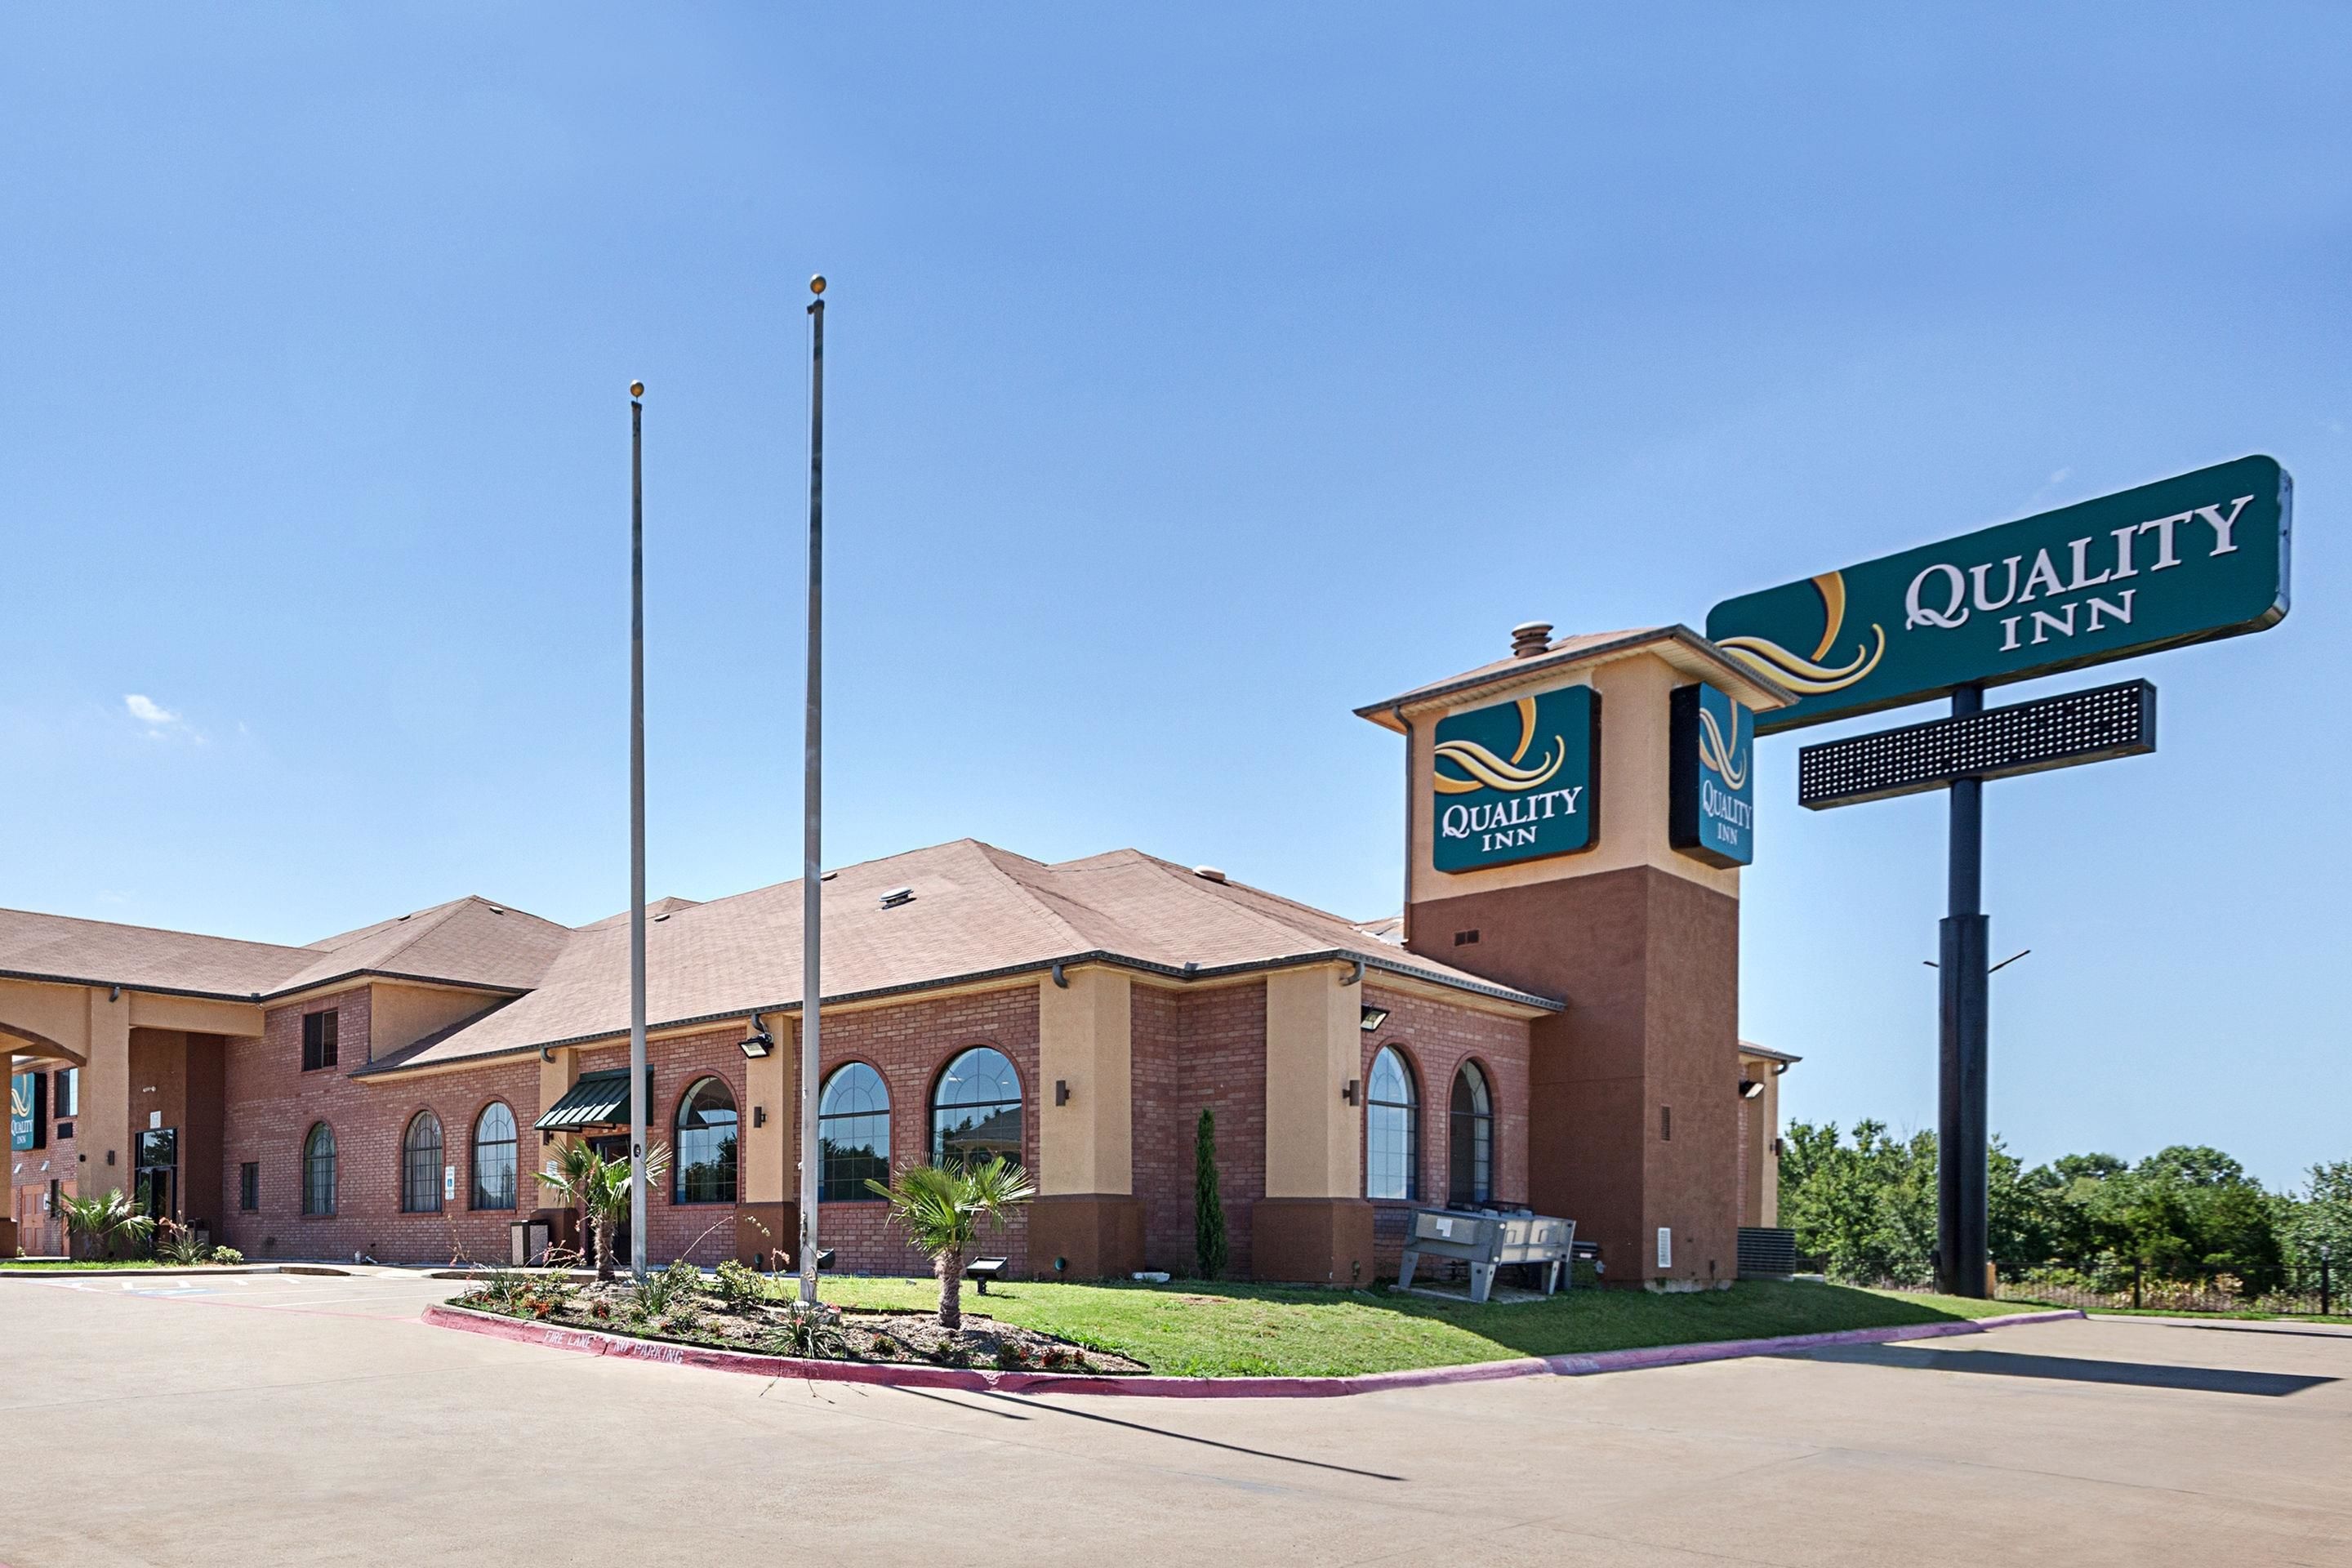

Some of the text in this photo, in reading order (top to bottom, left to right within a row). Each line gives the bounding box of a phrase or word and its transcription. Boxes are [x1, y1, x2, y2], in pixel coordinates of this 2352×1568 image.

[1905, 495, 2254, 630] QUALITY
[1999, 589, 2136, 652] INN
[1442, 786, 1583, 839] QUALITY
[1703, 779, 1753, 830] QUALITY
[1481, 826, 1537, 852] INN
[1717, 822, 1738, 845] INN
[11, 1119, 33, 1136] QUALITY
[543, 1330, 565, 1344] FIRE
[633, 1341, 684, 1364] PARKING
